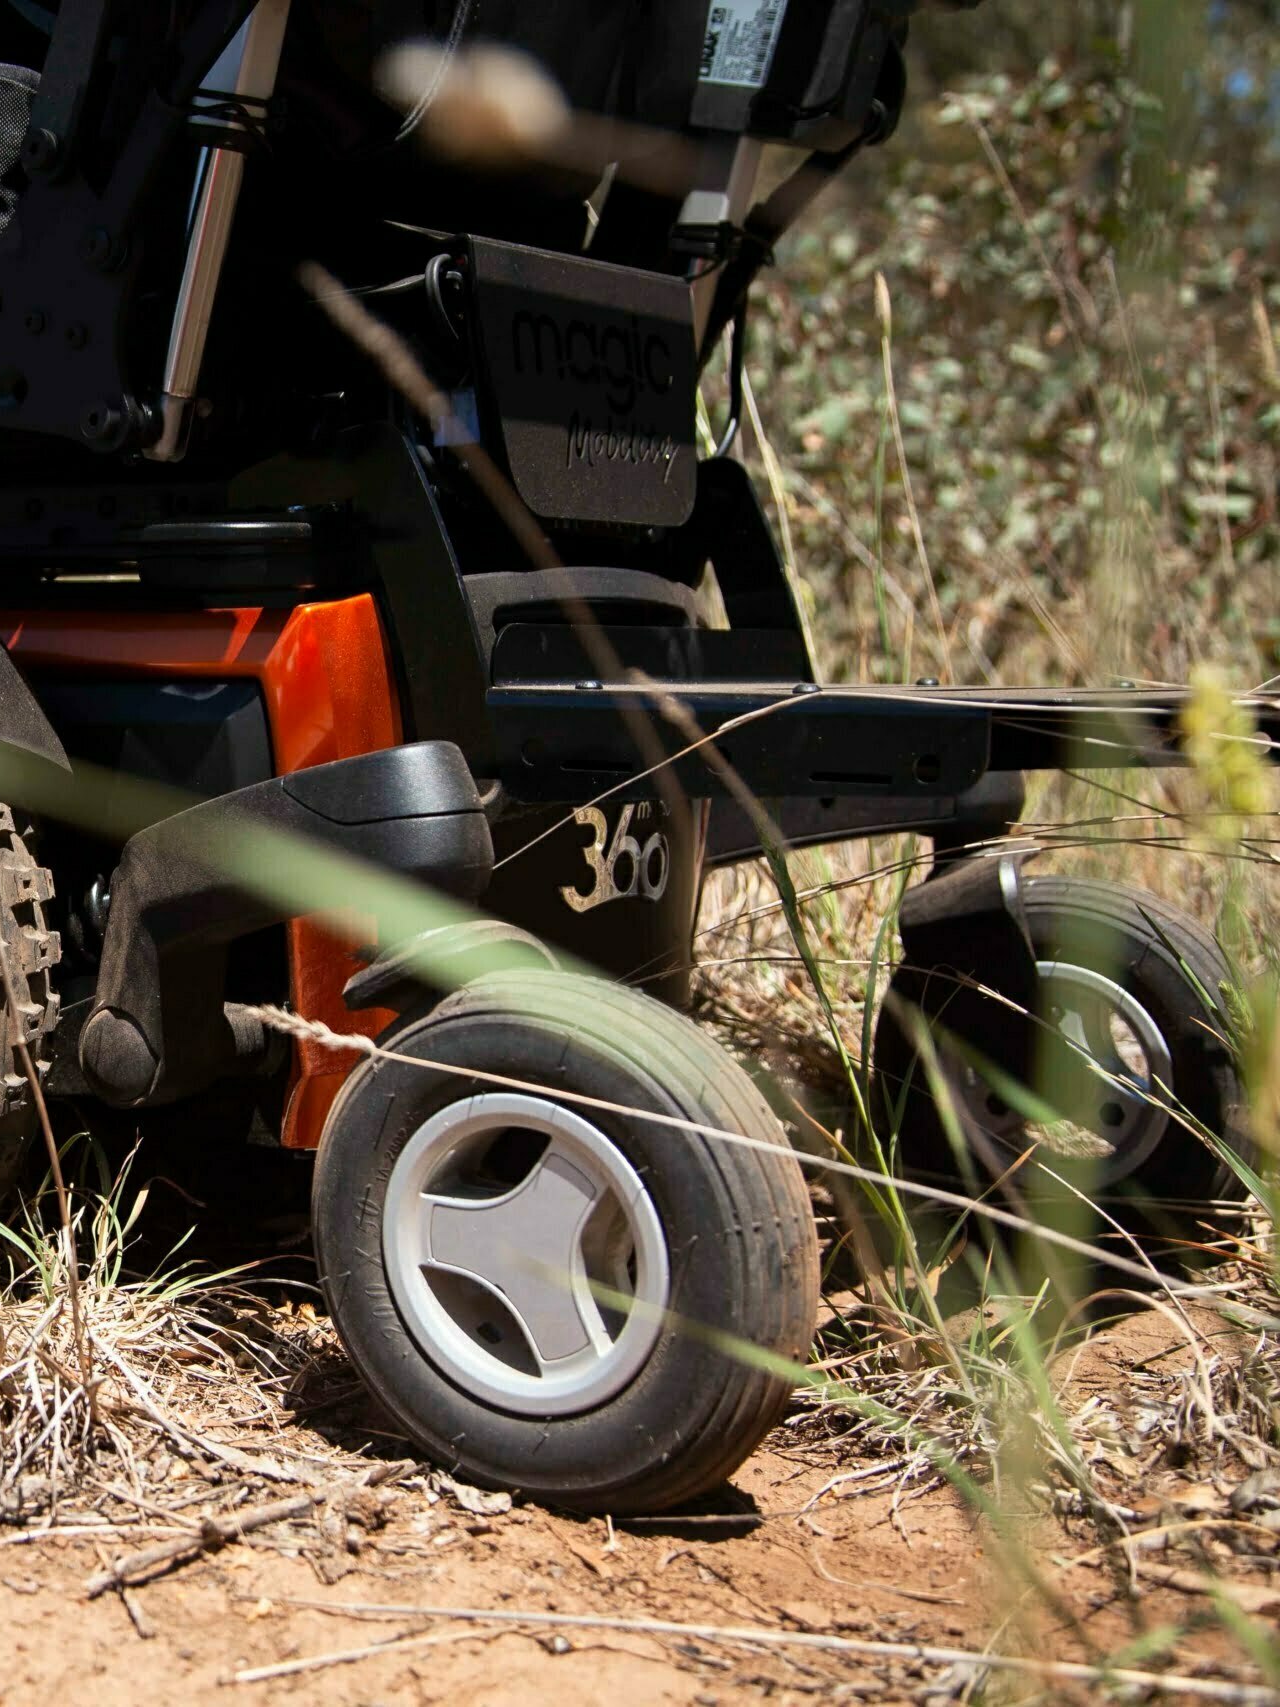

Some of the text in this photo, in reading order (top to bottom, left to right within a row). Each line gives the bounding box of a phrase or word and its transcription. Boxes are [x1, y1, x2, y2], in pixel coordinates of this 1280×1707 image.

[512, 310, 672, 414] magic
[566, 410, 680, 484] Mobility
[558, 803, 670, 913] 360
